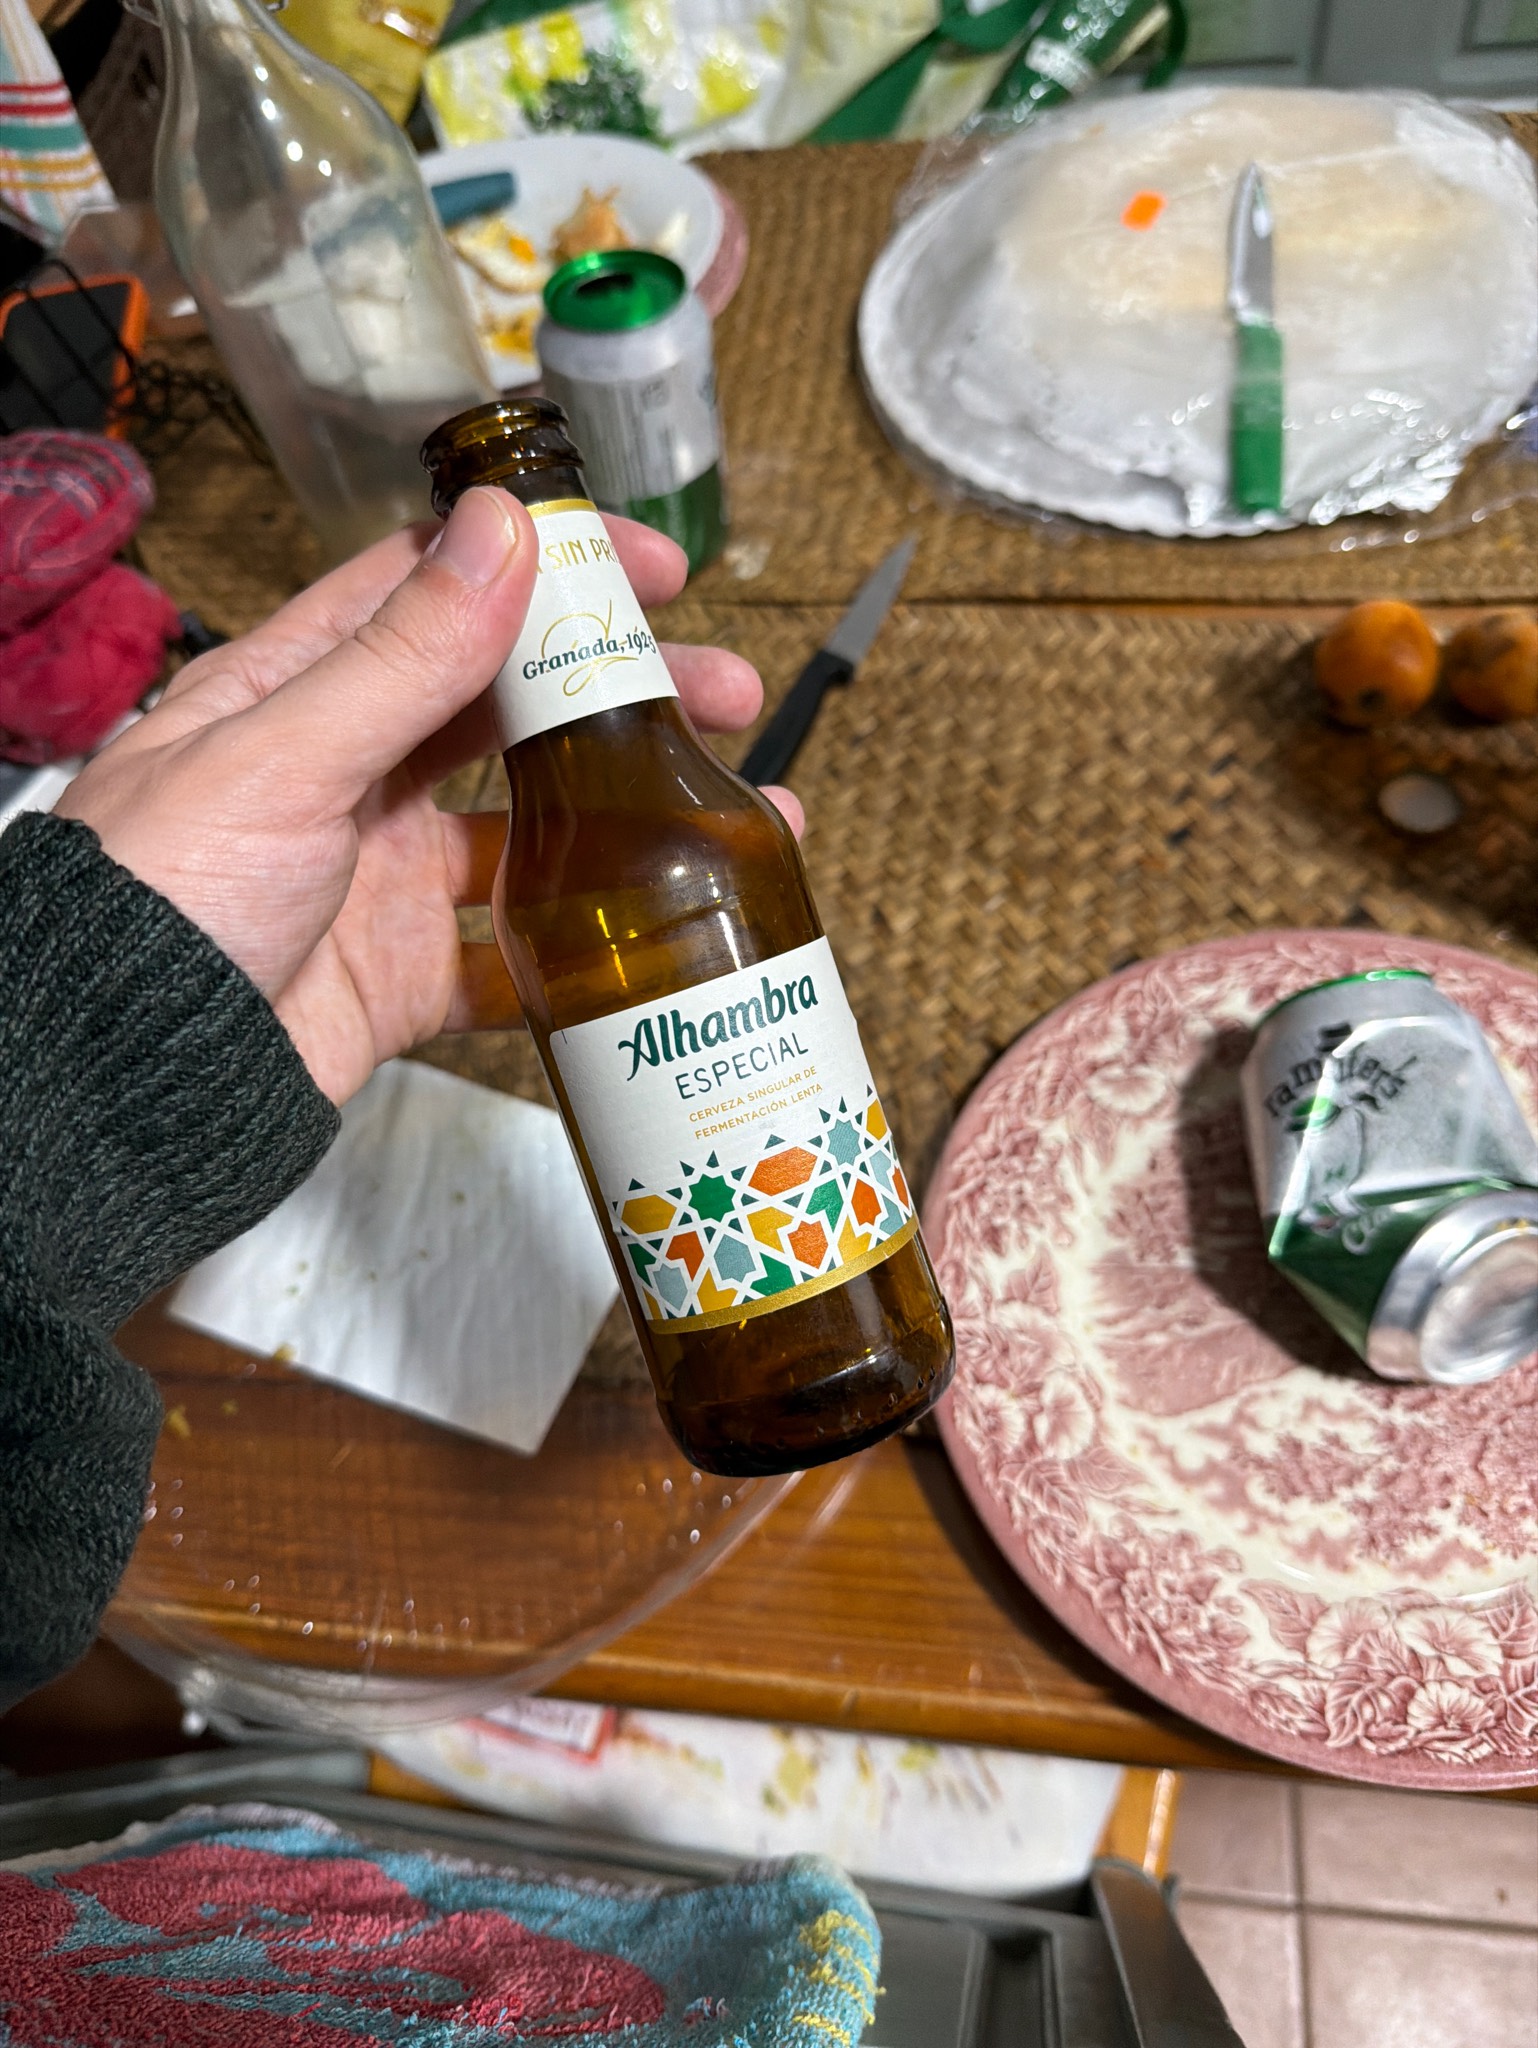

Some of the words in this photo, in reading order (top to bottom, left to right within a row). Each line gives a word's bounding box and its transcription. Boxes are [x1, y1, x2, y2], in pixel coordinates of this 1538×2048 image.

[544, 539, 588, 570] SIN
[523, 638, 626, 680] Granada,
[626, 630, 657, 656] 1925
[618, 975, 819, 1081] Alhambra
[675, 1032, 809, 1100] ESPECIAL
[689, 1096, 745, 1122] CERVEZA
[747, 1073, 802, 1102] SINGULAR
[803, 1066, 817, 1079] DE
[695, 1099, 788, 1140] FERMENTACIÓN
[791, 1083, 823, 1103] LENTA
